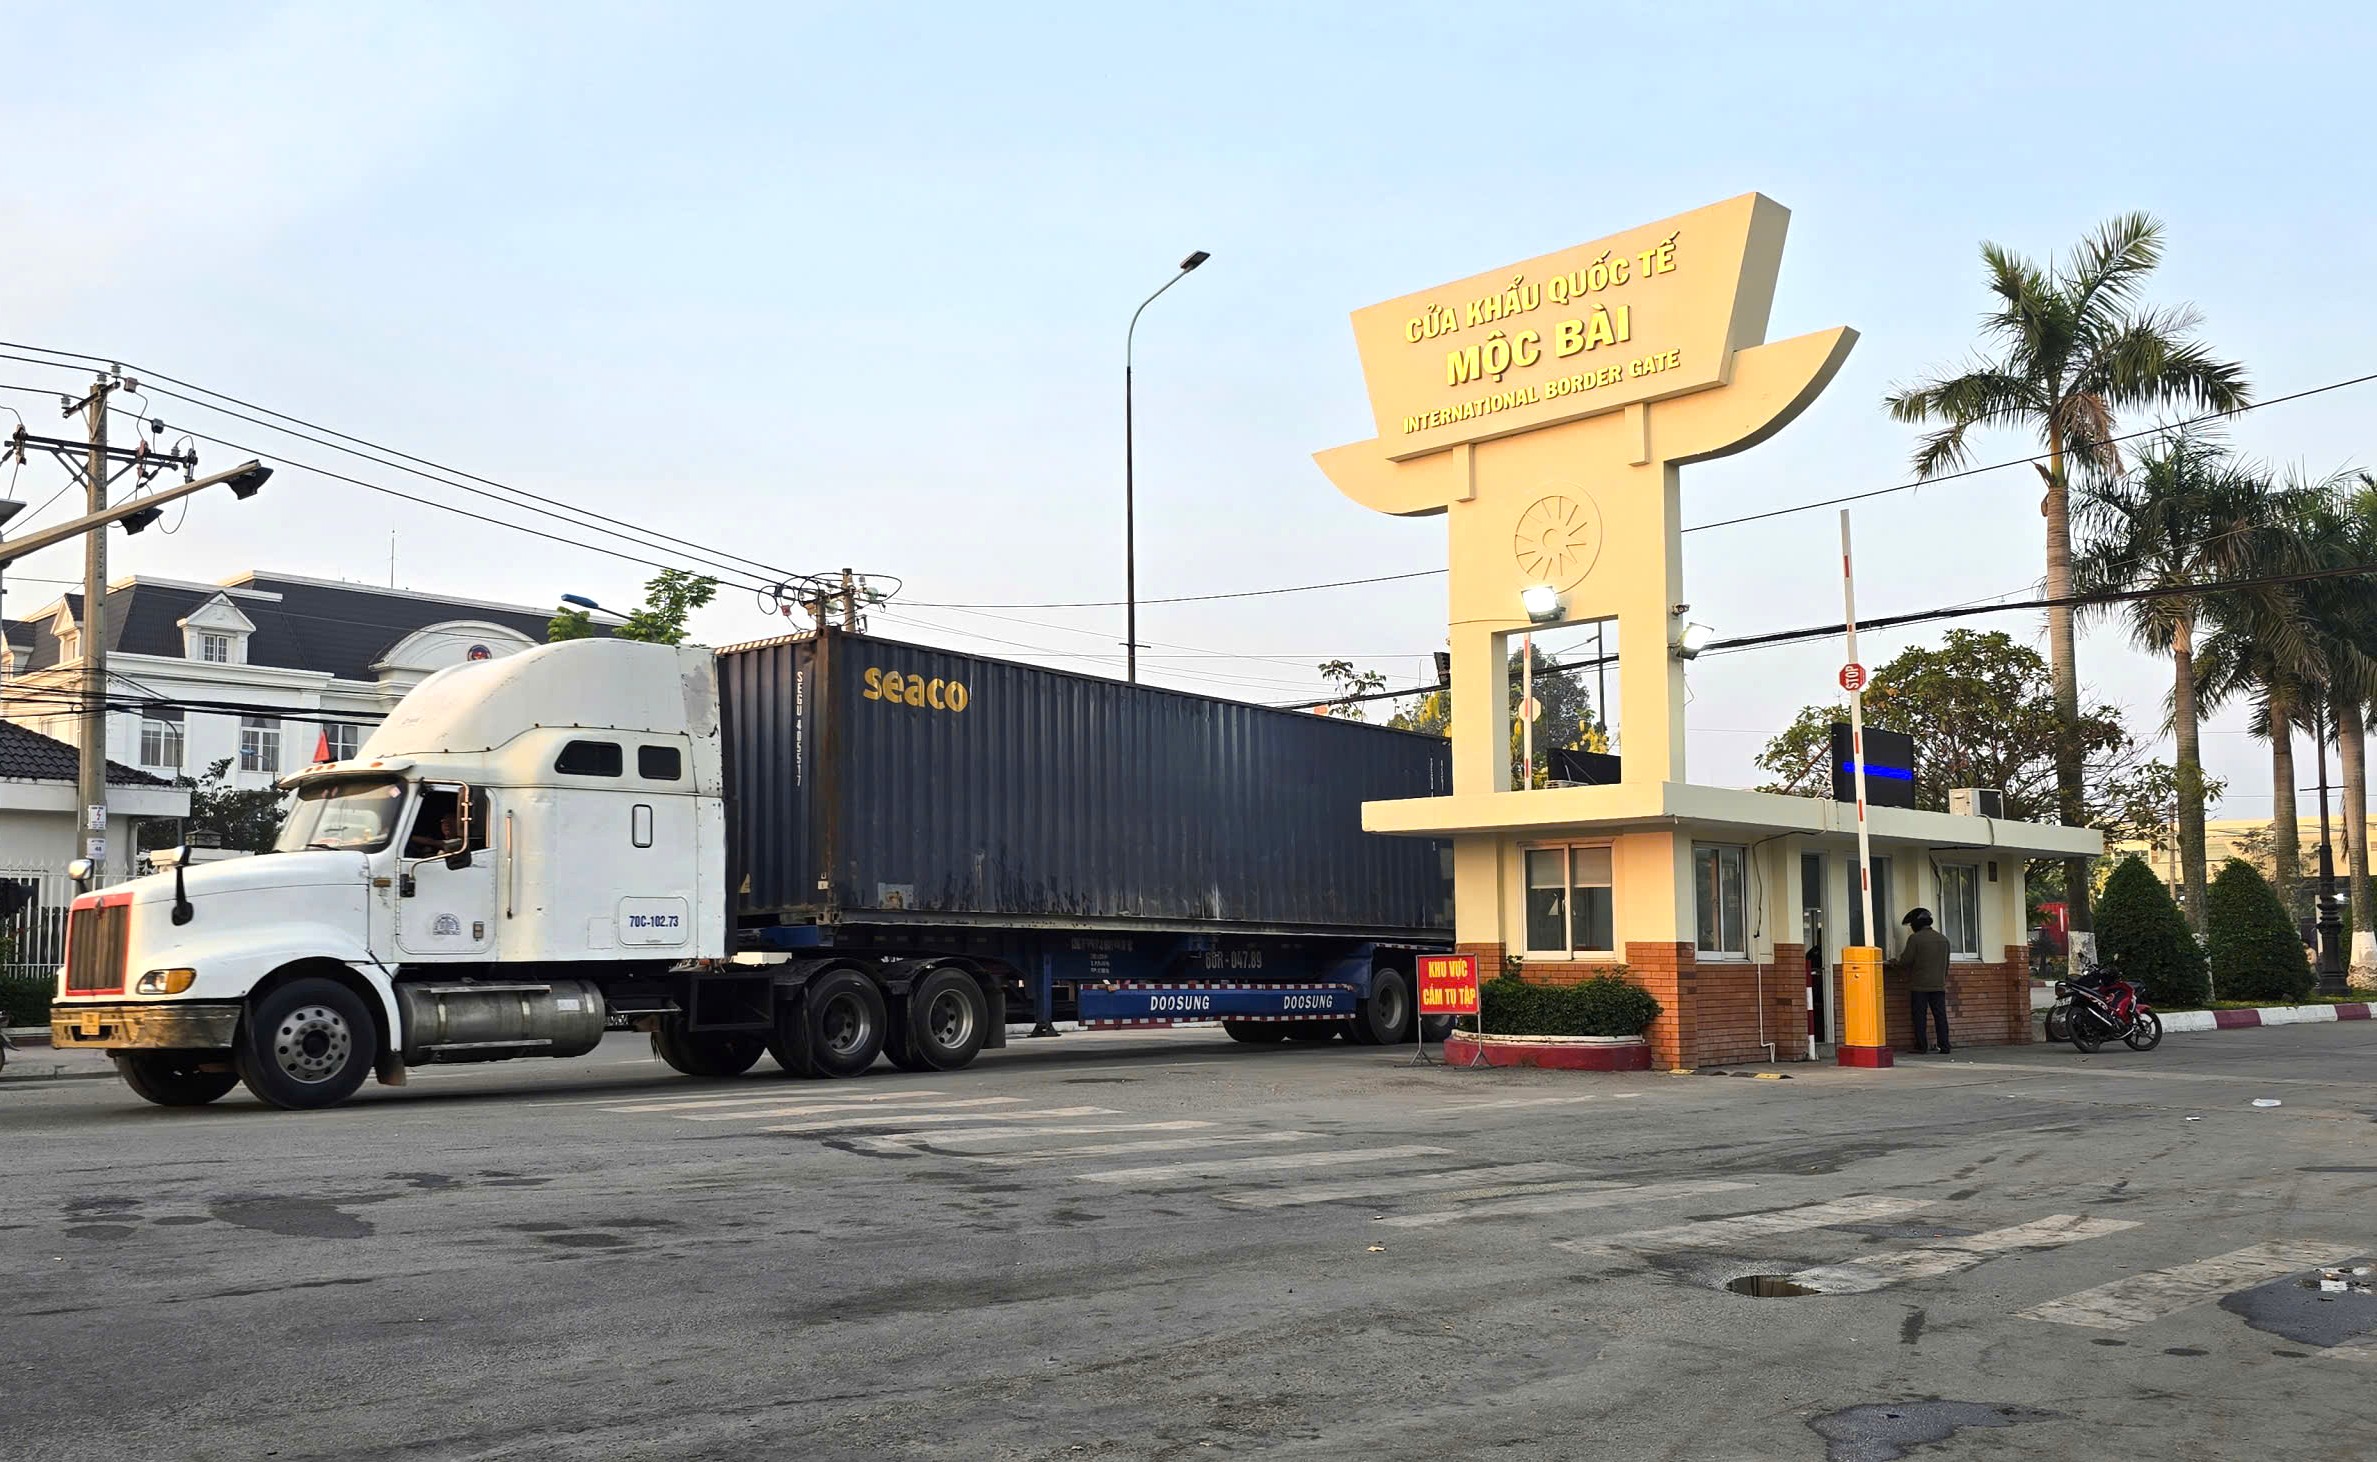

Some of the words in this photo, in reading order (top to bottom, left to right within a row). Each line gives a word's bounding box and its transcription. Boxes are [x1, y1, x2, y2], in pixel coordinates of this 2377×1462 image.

[1405, 303, 1459, 343] CỬA
[1465, 274, 1540, 328] KHẨU
[1548, 250, 1630, 305] QUỐC
[1637, 231, 1680, 278] TẾ
[1447, 329, 1540, 386] MỘC
[1555, 303, 1631, 358] BÀI
[1403, 386, 1539, 434] INTERNATIONAL
[1544, 364, 1622, 401] BORDER
[1628, 348, 1681, 378] GATE
[1844, 665, 1860, 689] STOP
[863, 667, 969, 713] seaco
[629, 915, 679, 928] 70C-102.73
[1428, 961, 1447, 978] KHU
[1449, 958, 1468, 980] VỰC
[1150, 995, 1210, 1011] DOOSUNG
[1283, 994, 1333, 1010] DOOSUNG
[1423, 983, 1443, 1005] CẤM
[1445, 988, 1457, 1008] TỤ
[1458, 985, 1476, 1008] TẬP
